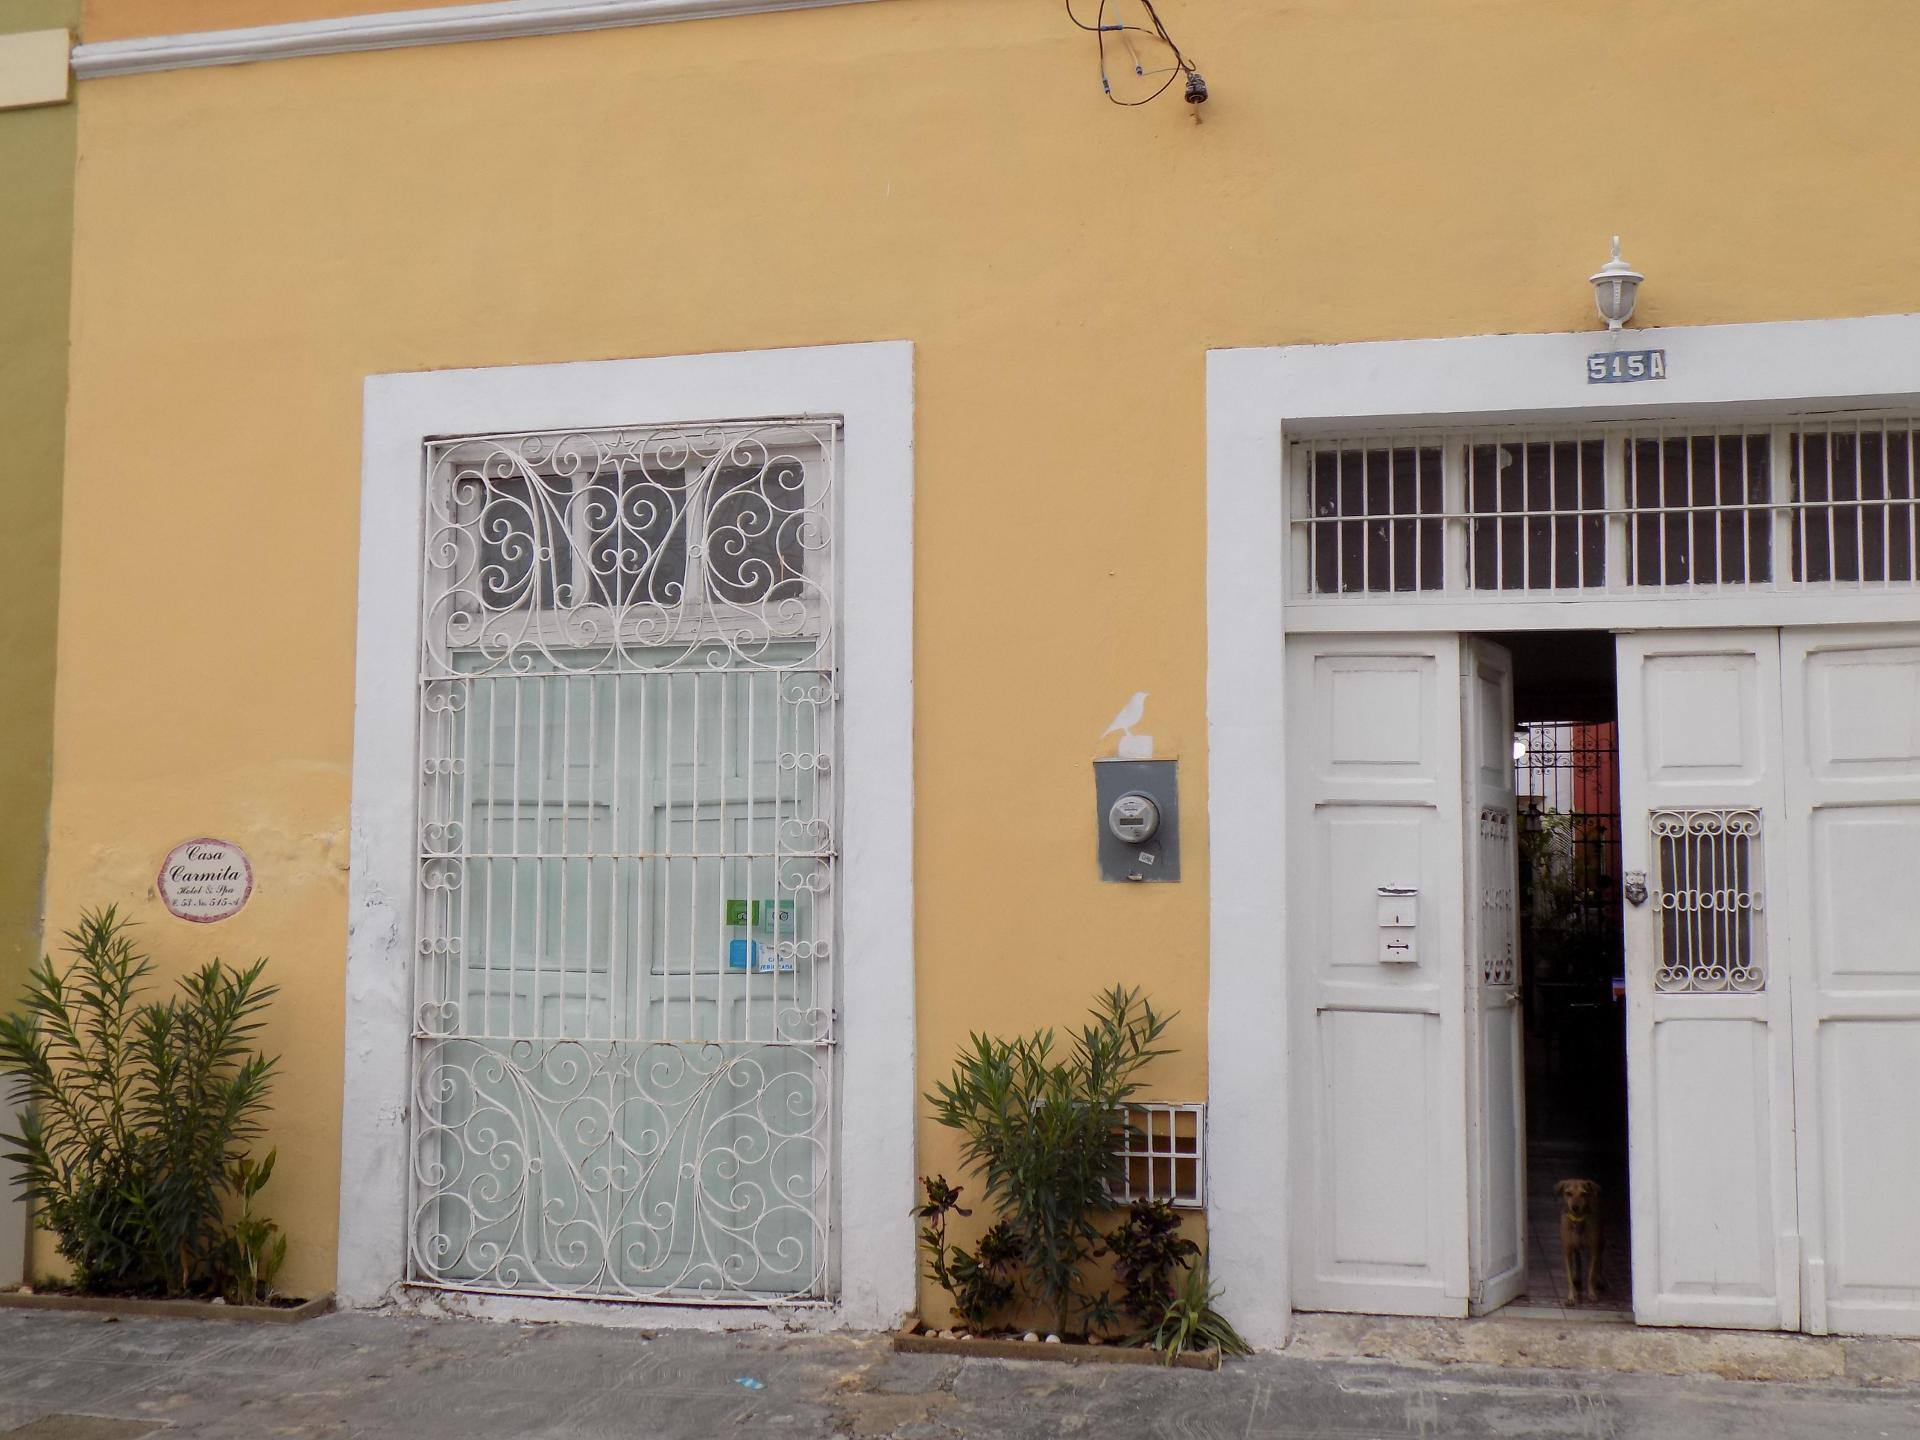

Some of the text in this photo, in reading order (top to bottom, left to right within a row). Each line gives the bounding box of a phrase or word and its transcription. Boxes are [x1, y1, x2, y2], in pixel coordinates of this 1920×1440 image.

[1589, 352, 1664, 379] 515A
[186, 846, 224, 861] Casa
[169, 865, 240, 883] Carmila
[177, 885, 234, 897] Hotel & Spa
